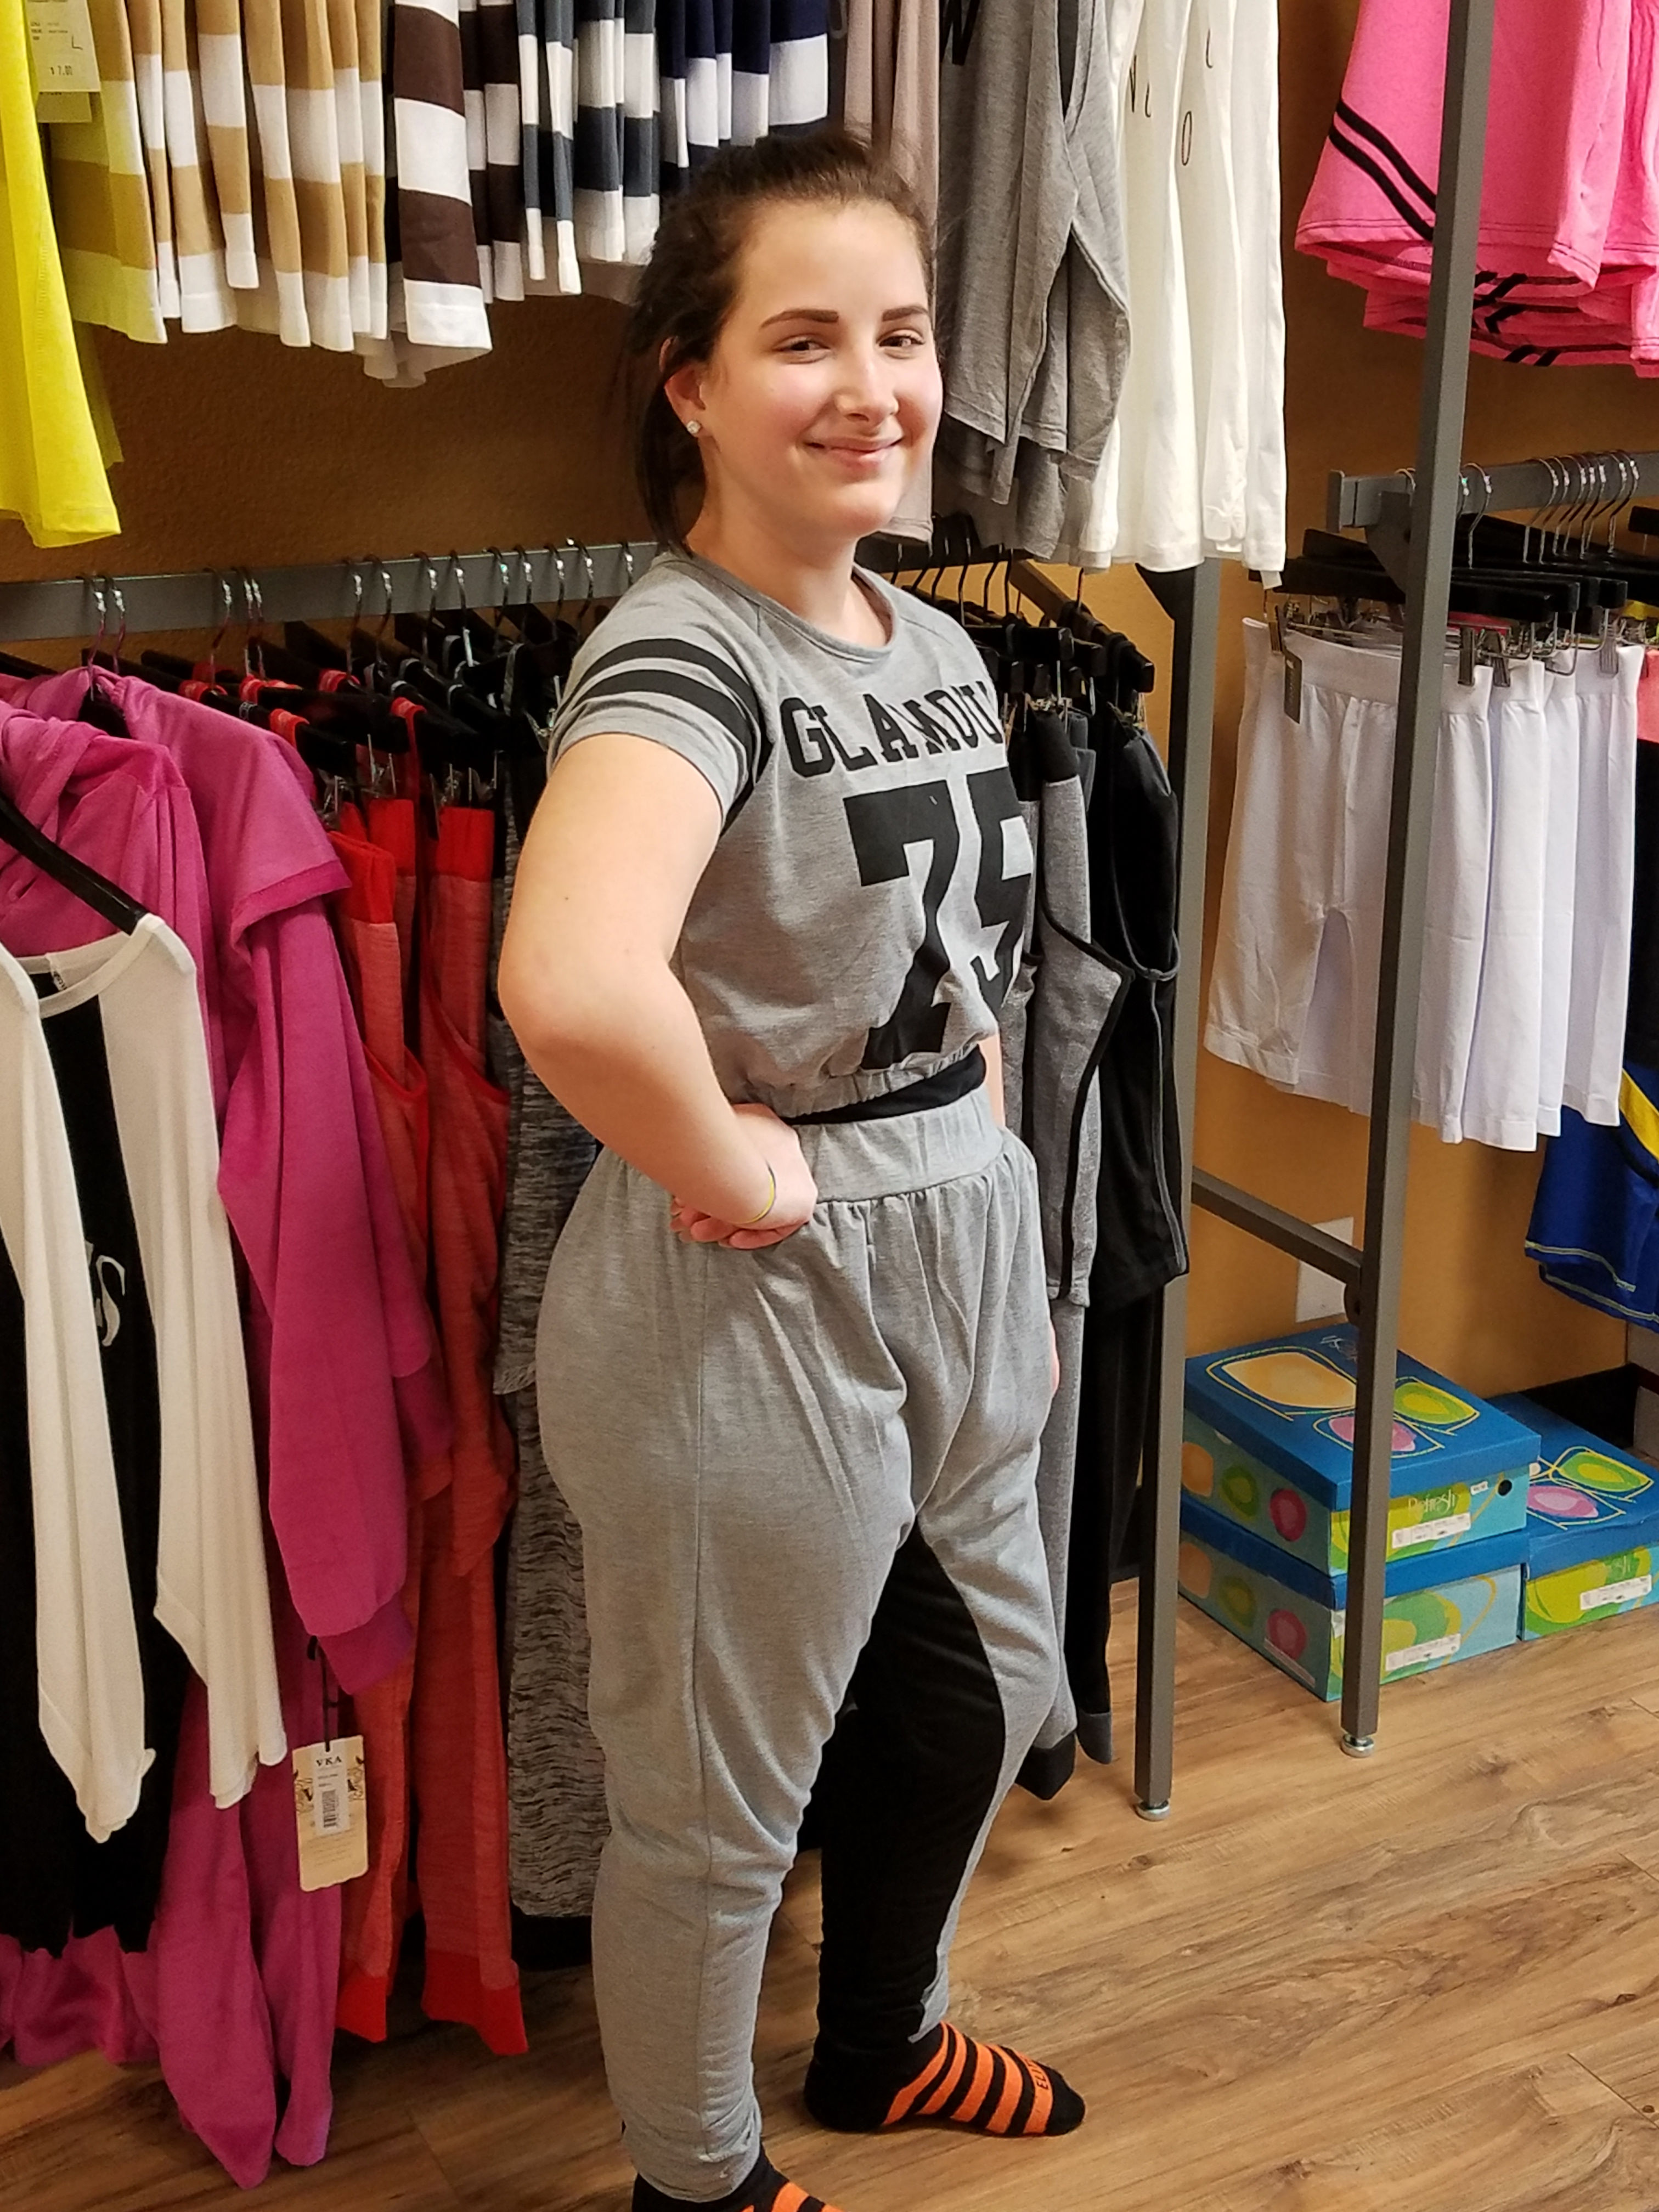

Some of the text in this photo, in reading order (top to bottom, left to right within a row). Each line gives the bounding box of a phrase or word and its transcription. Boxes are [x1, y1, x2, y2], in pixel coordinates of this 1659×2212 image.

[779, 680, 1003, 778] GLAMOU
[843, 766, 1032, 1070] 75
[316, 1756, 342, 1767] VKA
